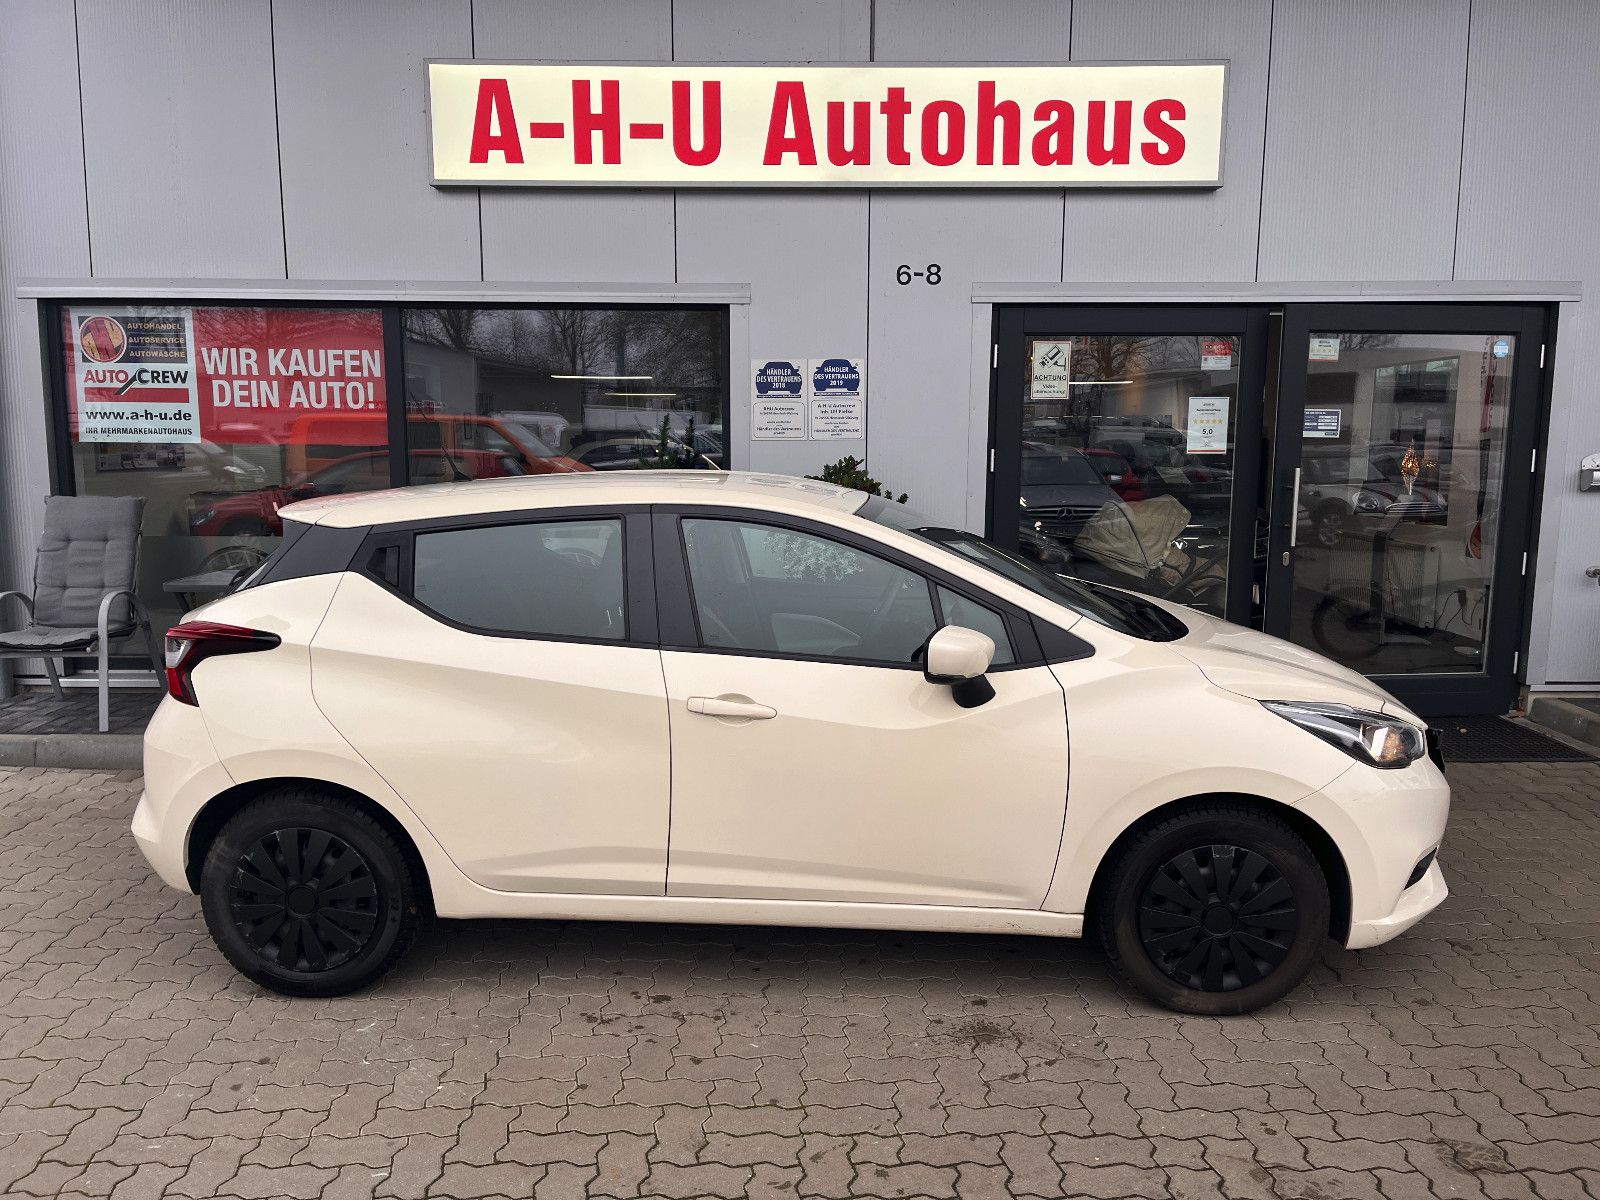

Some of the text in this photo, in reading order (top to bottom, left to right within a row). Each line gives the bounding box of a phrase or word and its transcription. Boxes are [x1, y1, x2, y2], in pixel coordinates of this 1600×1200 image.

[470, 78, 1187, 167] A-H-U Autohaus
[896, 263, 942, 286] 6-8
[127, 322, 182, 330] AUTOHANDEL
[201, 347, 382, 378] WIR KAUFEN
[824, 365, 849, 373] HÄNDLER
[757, 375, 802, 383] DES VERTRAUENS
[212, 379, 375, 410] DEIN AUTO!
[85, 409, 192, 421] www.a-h-u.de
[85, 427, 193, 436] IHR MEHRMARKENAUTOHAUS
[1202, 428, 1214, 436] 5,0
